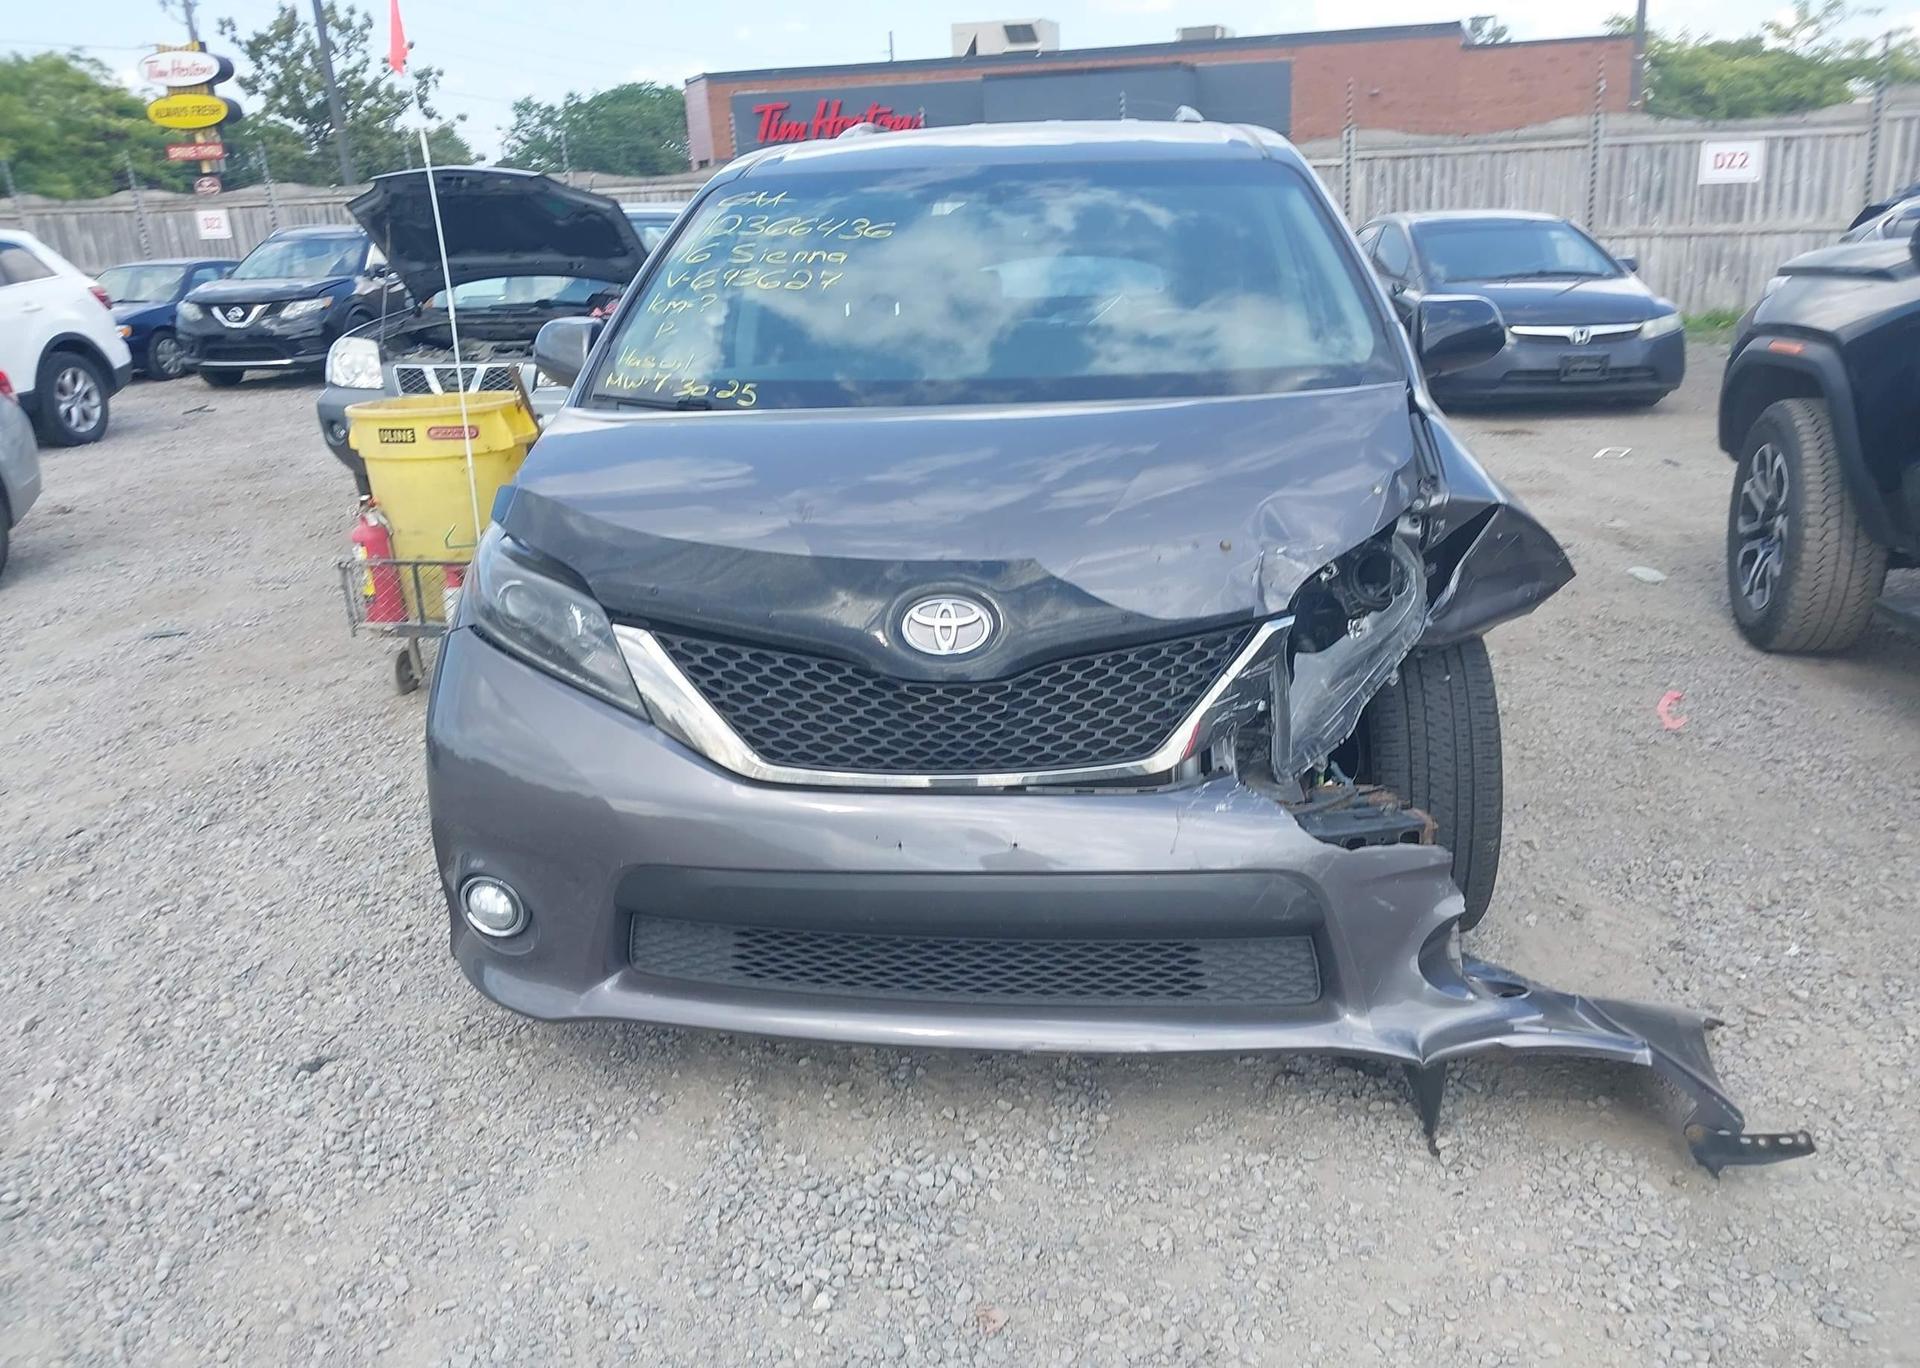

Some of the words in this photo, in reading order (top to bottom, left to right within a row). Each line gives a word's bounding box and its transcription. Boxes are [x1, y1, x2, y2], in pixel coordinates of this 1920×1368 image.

[753, 102, 807, 144] Tim
[702, 213, 897, 240] 10366436
[728, 243, 848, 264] Sienna
[380, 429, 415, 443] ULINE
